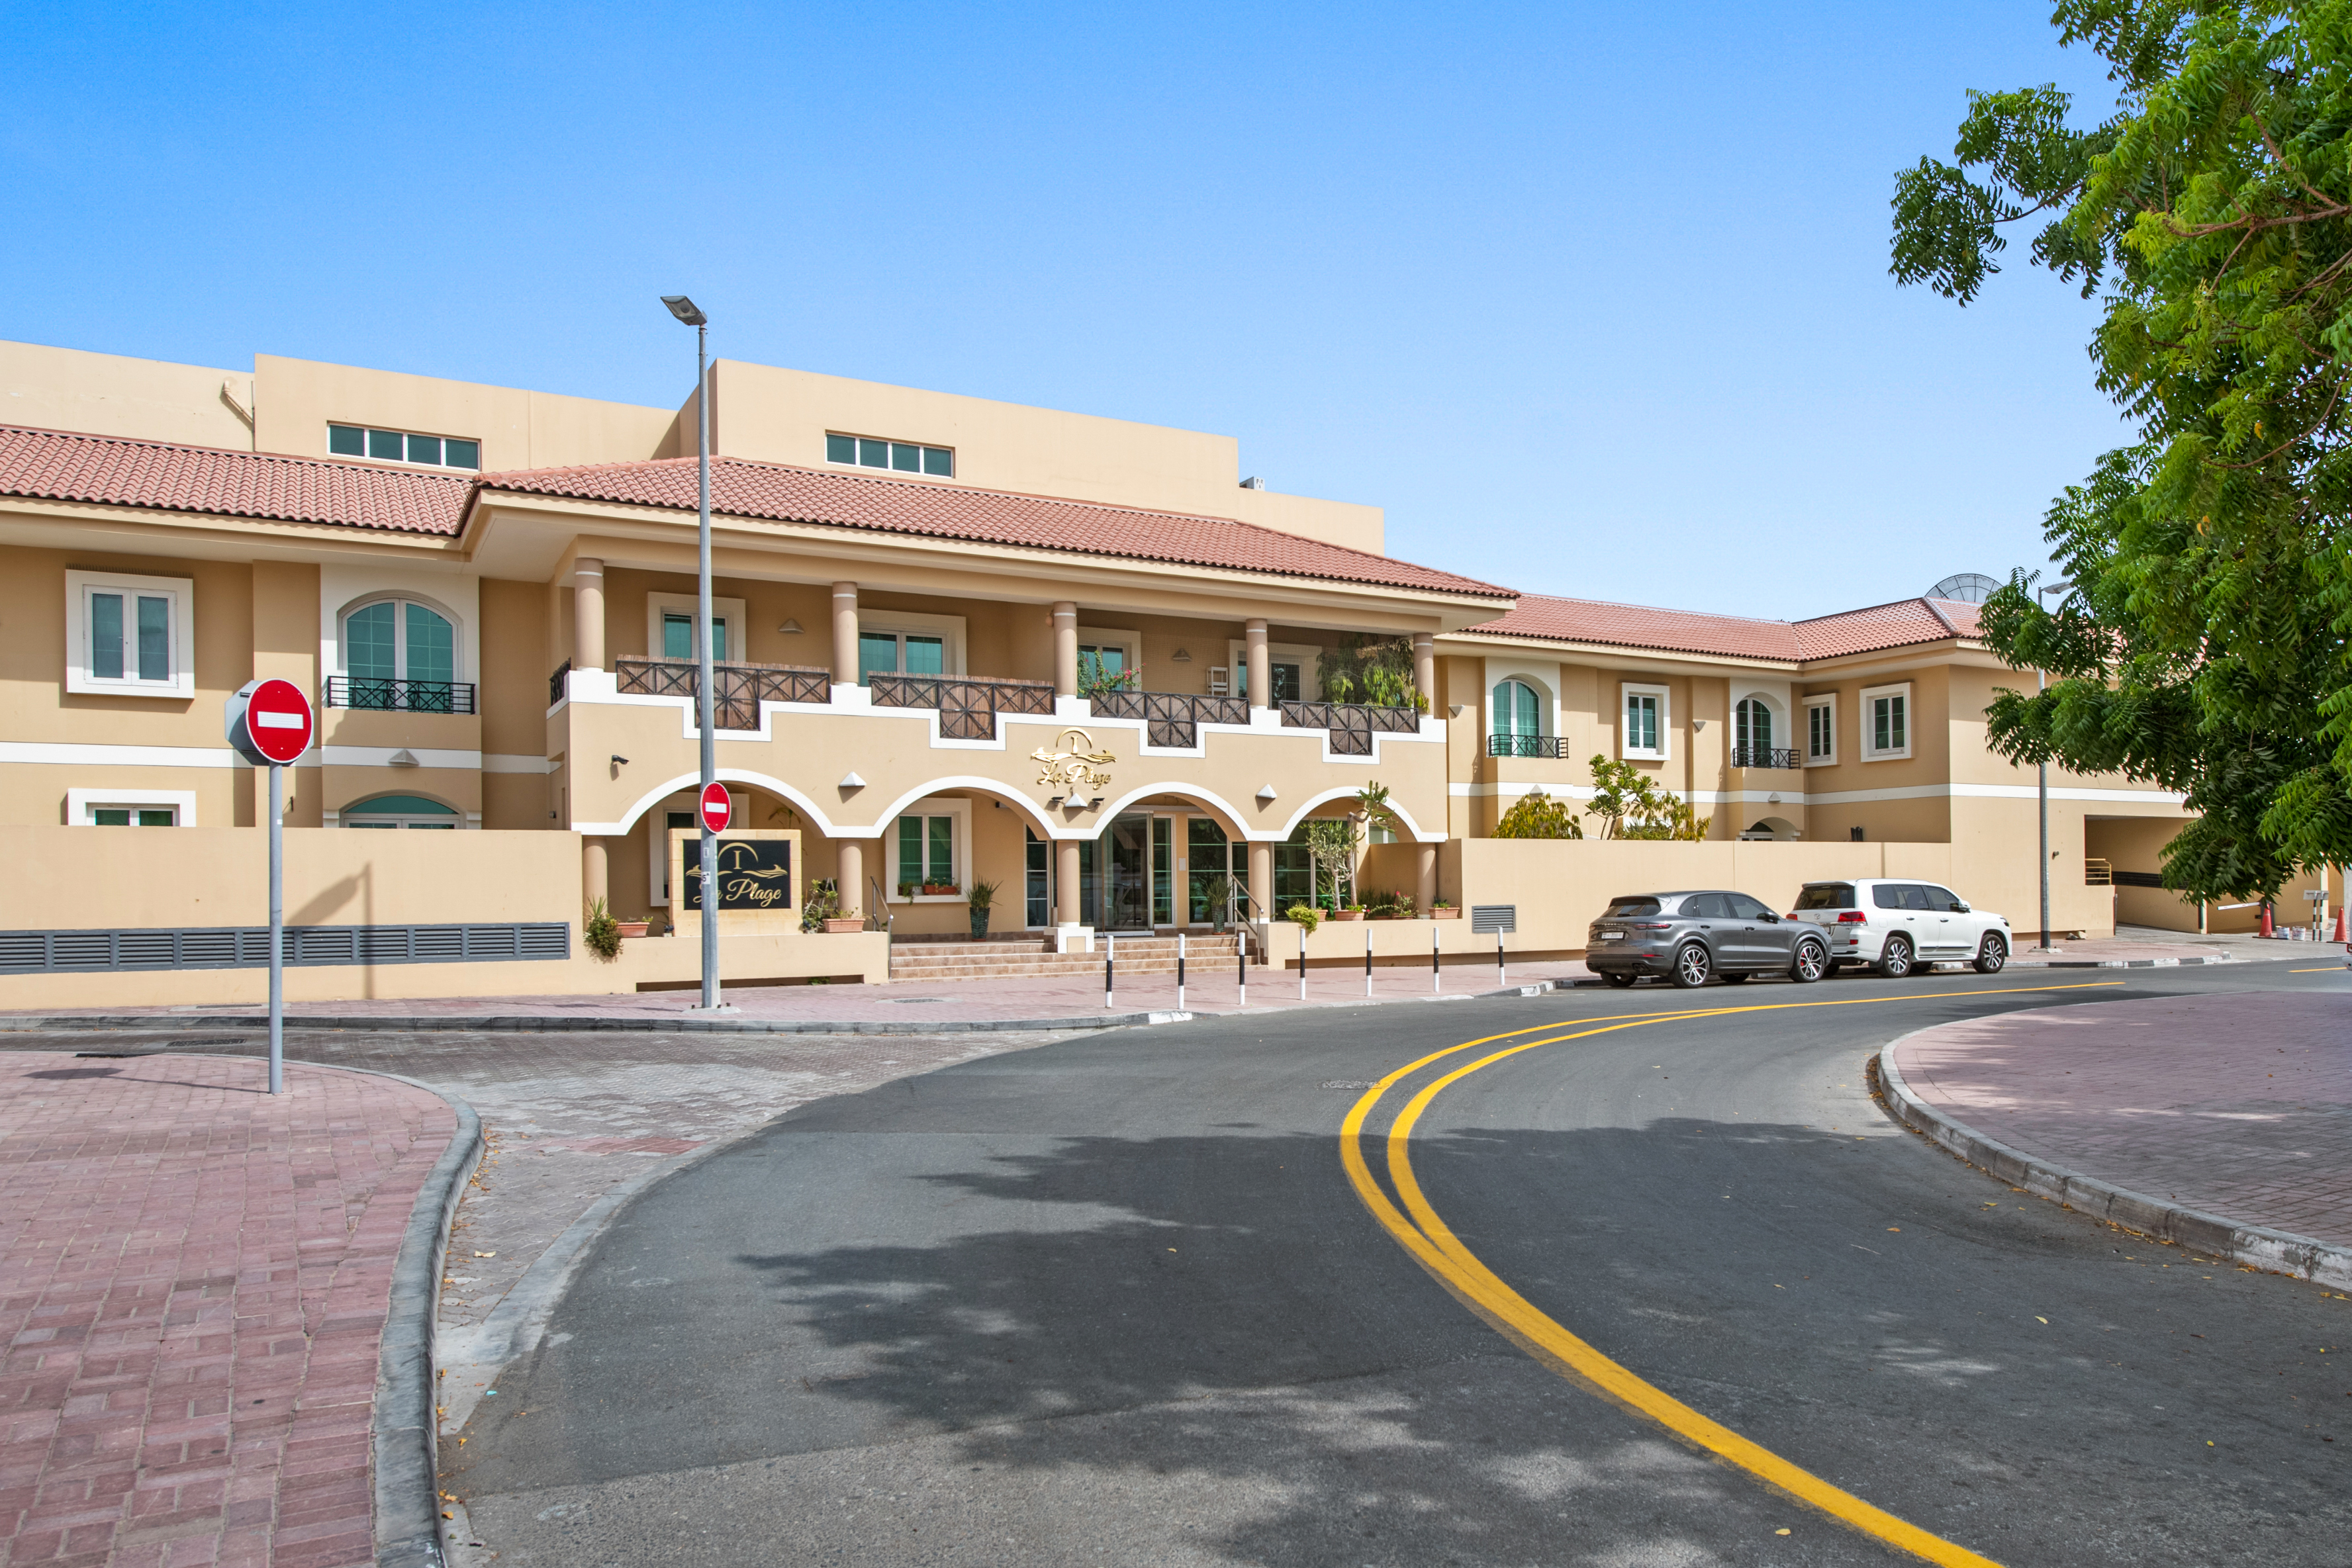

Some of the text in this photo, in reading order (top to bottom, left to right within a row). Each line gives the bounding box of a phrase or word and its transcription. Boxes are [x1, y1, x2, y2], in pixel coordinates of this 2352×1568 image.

[1037, 761, 1111, 790] La Plage
[726, 878, 782, 907] Plage
